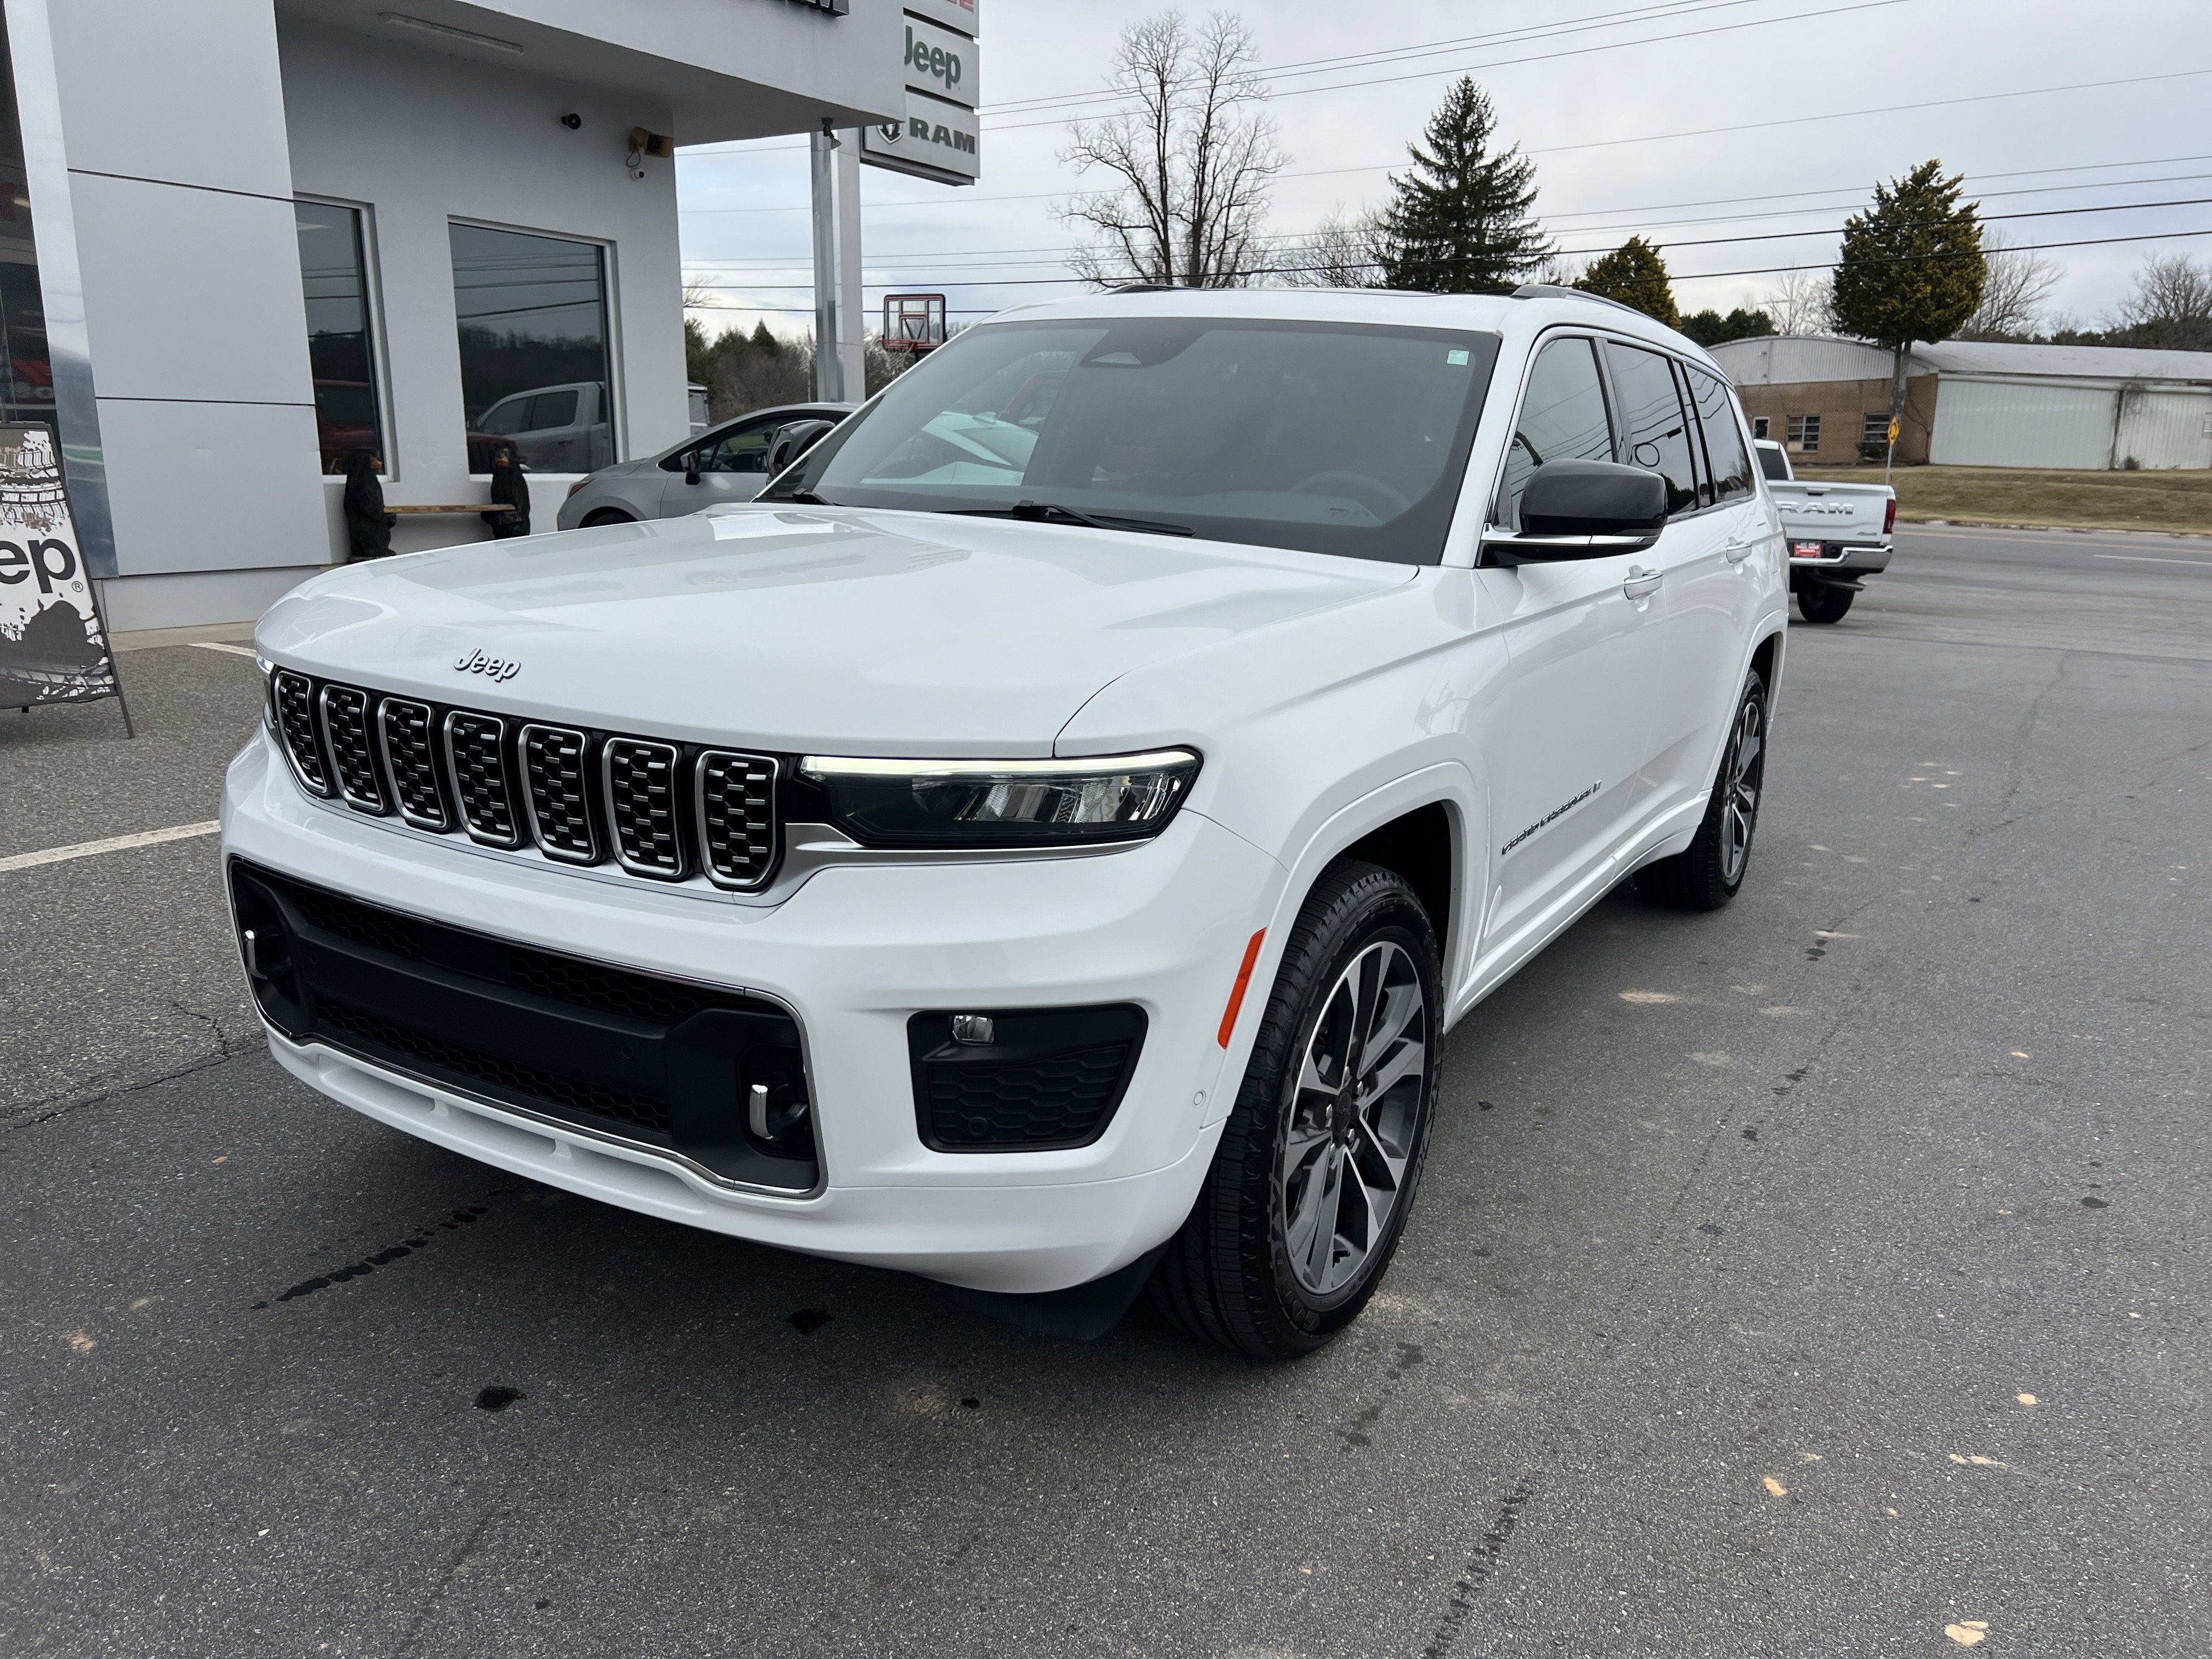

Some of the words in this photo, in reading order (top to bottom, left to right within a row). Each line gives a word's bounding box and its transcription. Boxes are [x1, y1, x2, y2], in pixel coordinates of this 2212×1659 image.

[904, 25, 961, 89] Jeep
[909, 116, 975, 155] RAM
[1775, 500, 1854, 515] RAM
[0, 538, 76, 594] ep
[454, 647, 521, 683] Jeep
